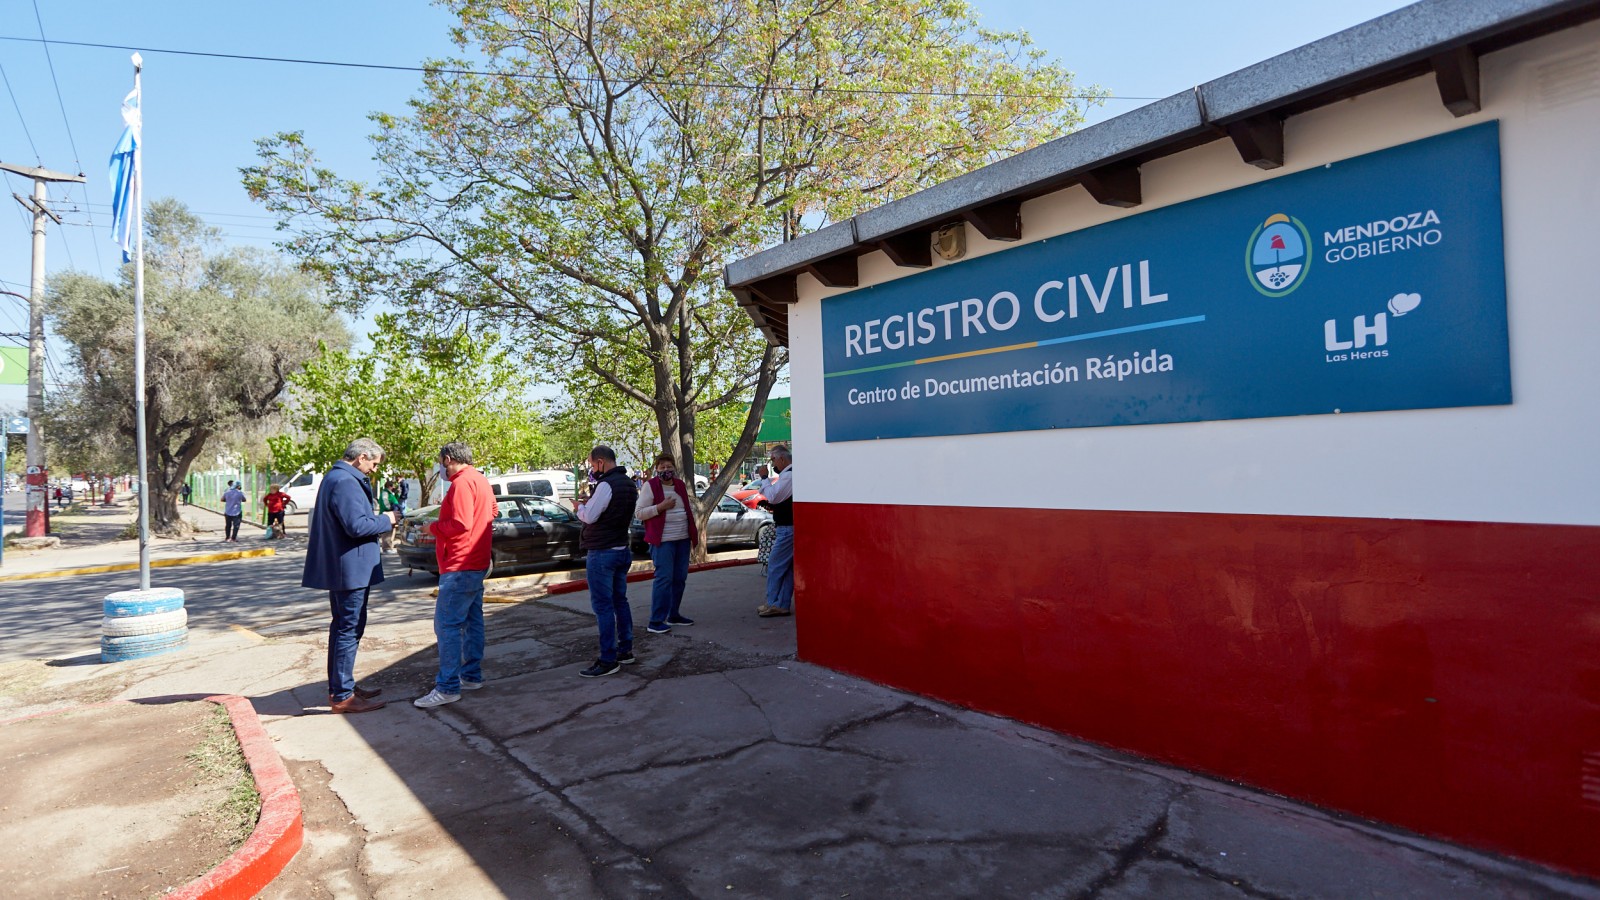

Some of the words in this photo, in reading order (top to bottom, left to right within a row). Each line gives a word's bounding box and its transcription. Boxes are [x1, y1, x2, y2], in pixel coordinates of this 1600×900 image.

[1325, 210, 1440, 246] MENDOZA
[1326, 230, 1441, 263] GOBIERNO
[846, 292, 1020, 357] REGISTRO
[1034, 260, 1168, 322] CIVIL
[1325, 313, 1387, 351] LH
[1326, 354, 1348, 363] Las
[1350, 349, 1389, 360] Heras
[847, 386, 897, 406] Centro
[900, 381, 921, 400] de
[925, 362, 1079, 397] Documentación
[1086, 348, 1174, 382] Rápida
